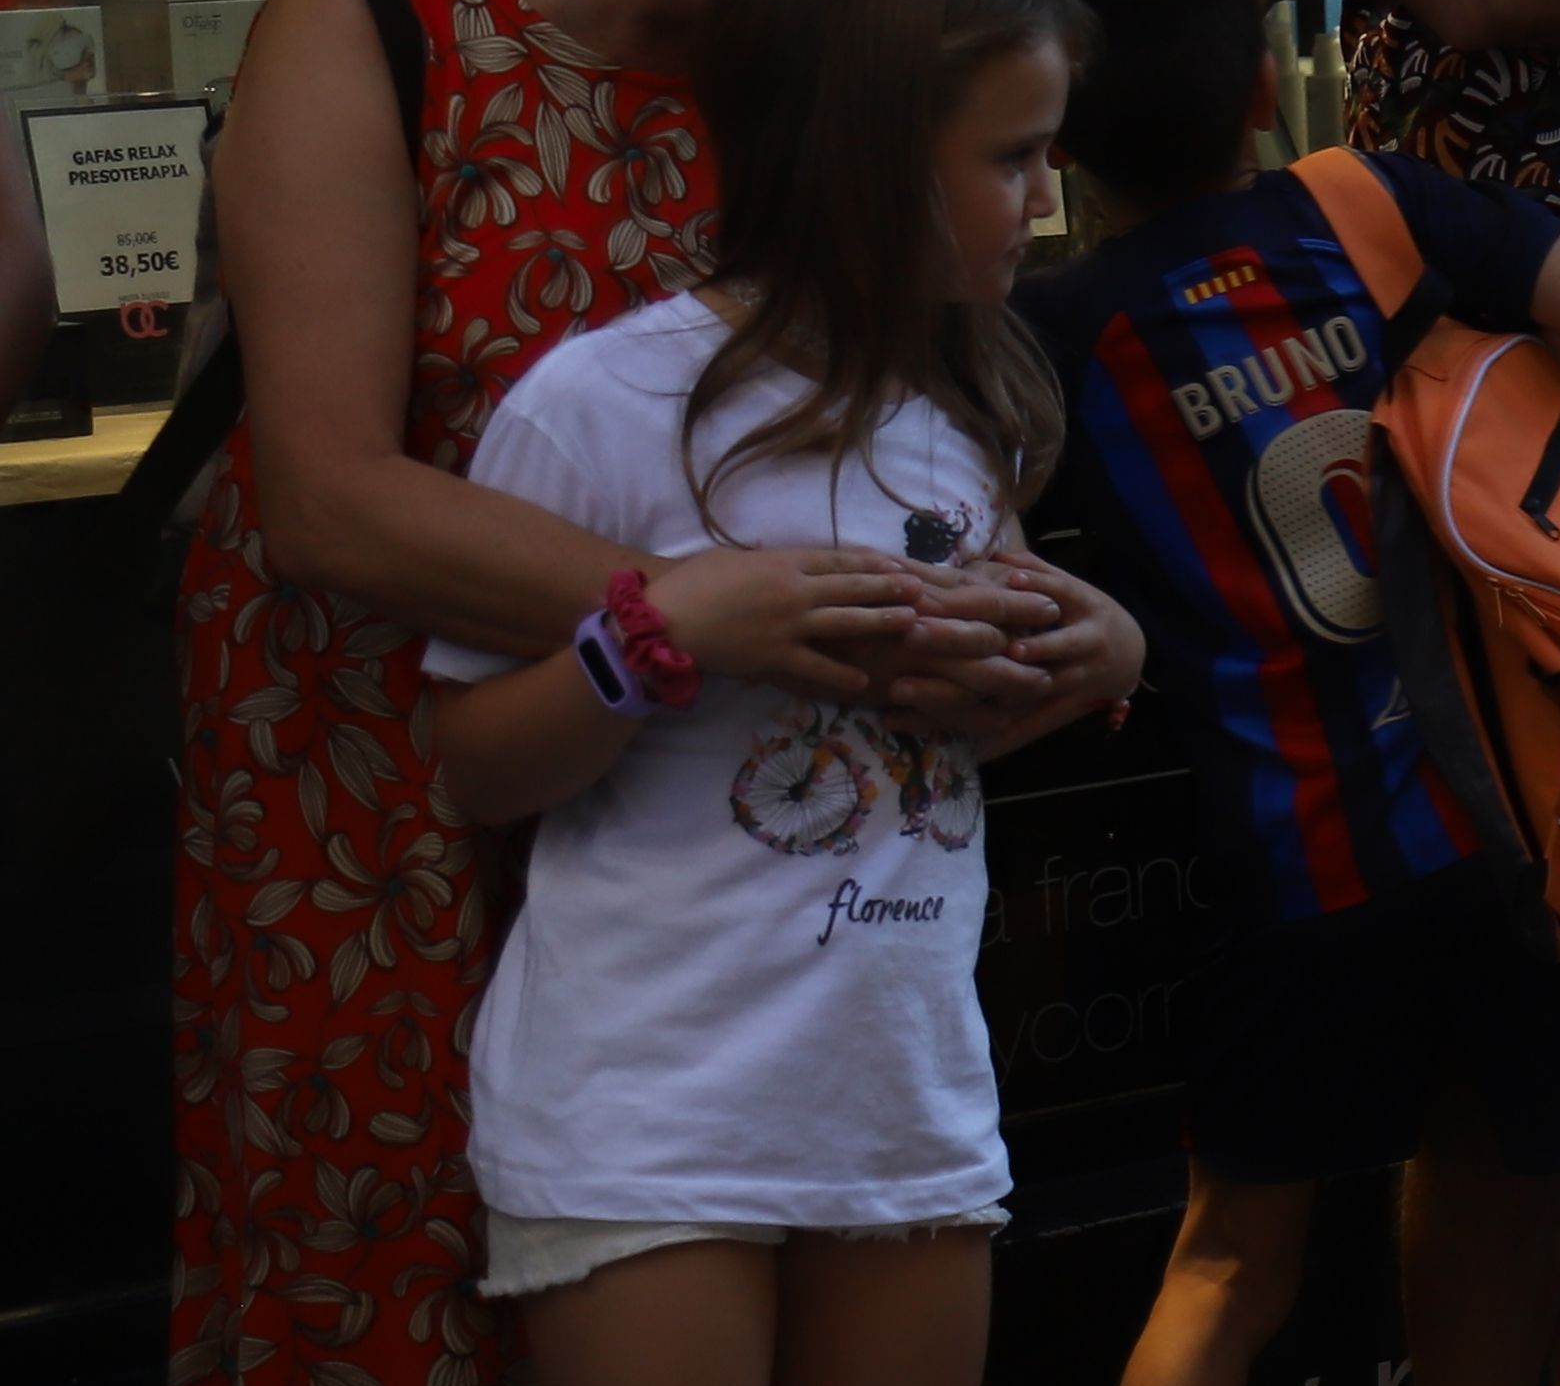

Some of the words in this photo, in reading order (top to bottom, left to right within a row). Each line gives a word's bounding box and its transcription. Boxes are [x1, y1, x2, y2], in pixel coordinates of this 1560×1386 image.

[72, 147, 125, 166] GAFAS
[128, 144, 178, 162] RELAX
[68, 163, 189, 186] PRESOTERAPIA
[115, 230, 159, 248] 85,00€
[100, 250, 181, 279] 38,50€
[1171, 314, 1369, 442] BRUNO
[818, 878, 945, 946] florence
